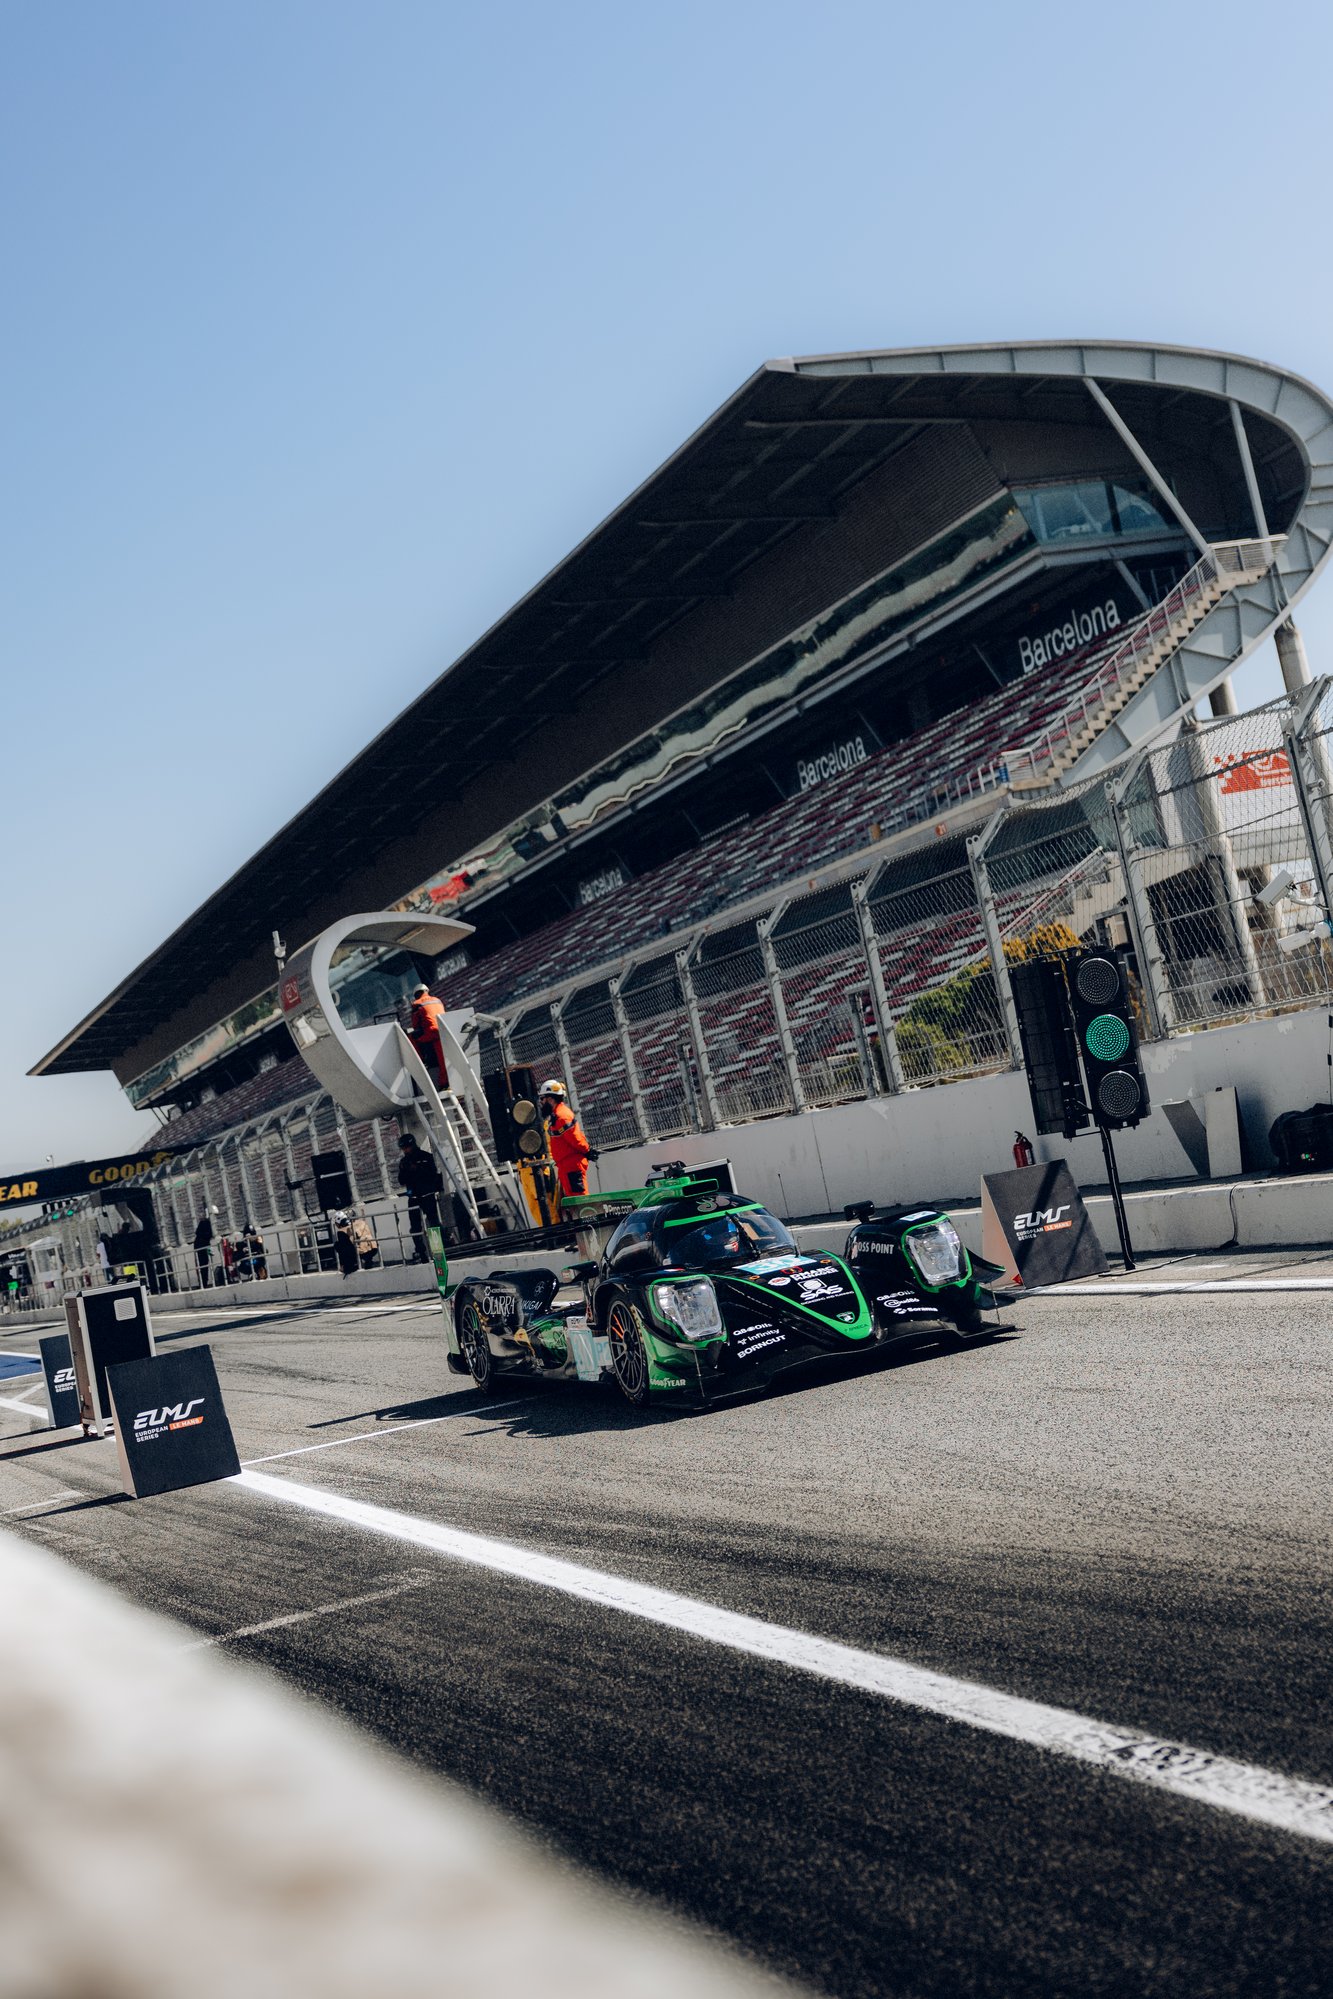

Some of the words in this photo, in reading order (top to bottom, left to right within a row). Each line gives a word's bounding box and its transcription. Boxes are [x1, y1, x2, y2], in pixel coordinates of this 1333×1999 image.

[1018, 599, 1121, 673] Barcelona
[797, 736, 867, 790] Barcelona
[1013, 1204, 1071, 1230] ELMS
[870, 1242, 894, 1254] POINT
[800, 1284, 843, 1301] SAS
[482, 1296, 515, 1316] OLARRA
[737, 1335, 786, 1358] BORNCUT
[133, 1398, 205, 1430] ELMS
[134, 1425, 169, 1438] EUROPEAN
[172, 1422, 182, 1430] LE
[136, 1433, 159, 1443] SERIES
